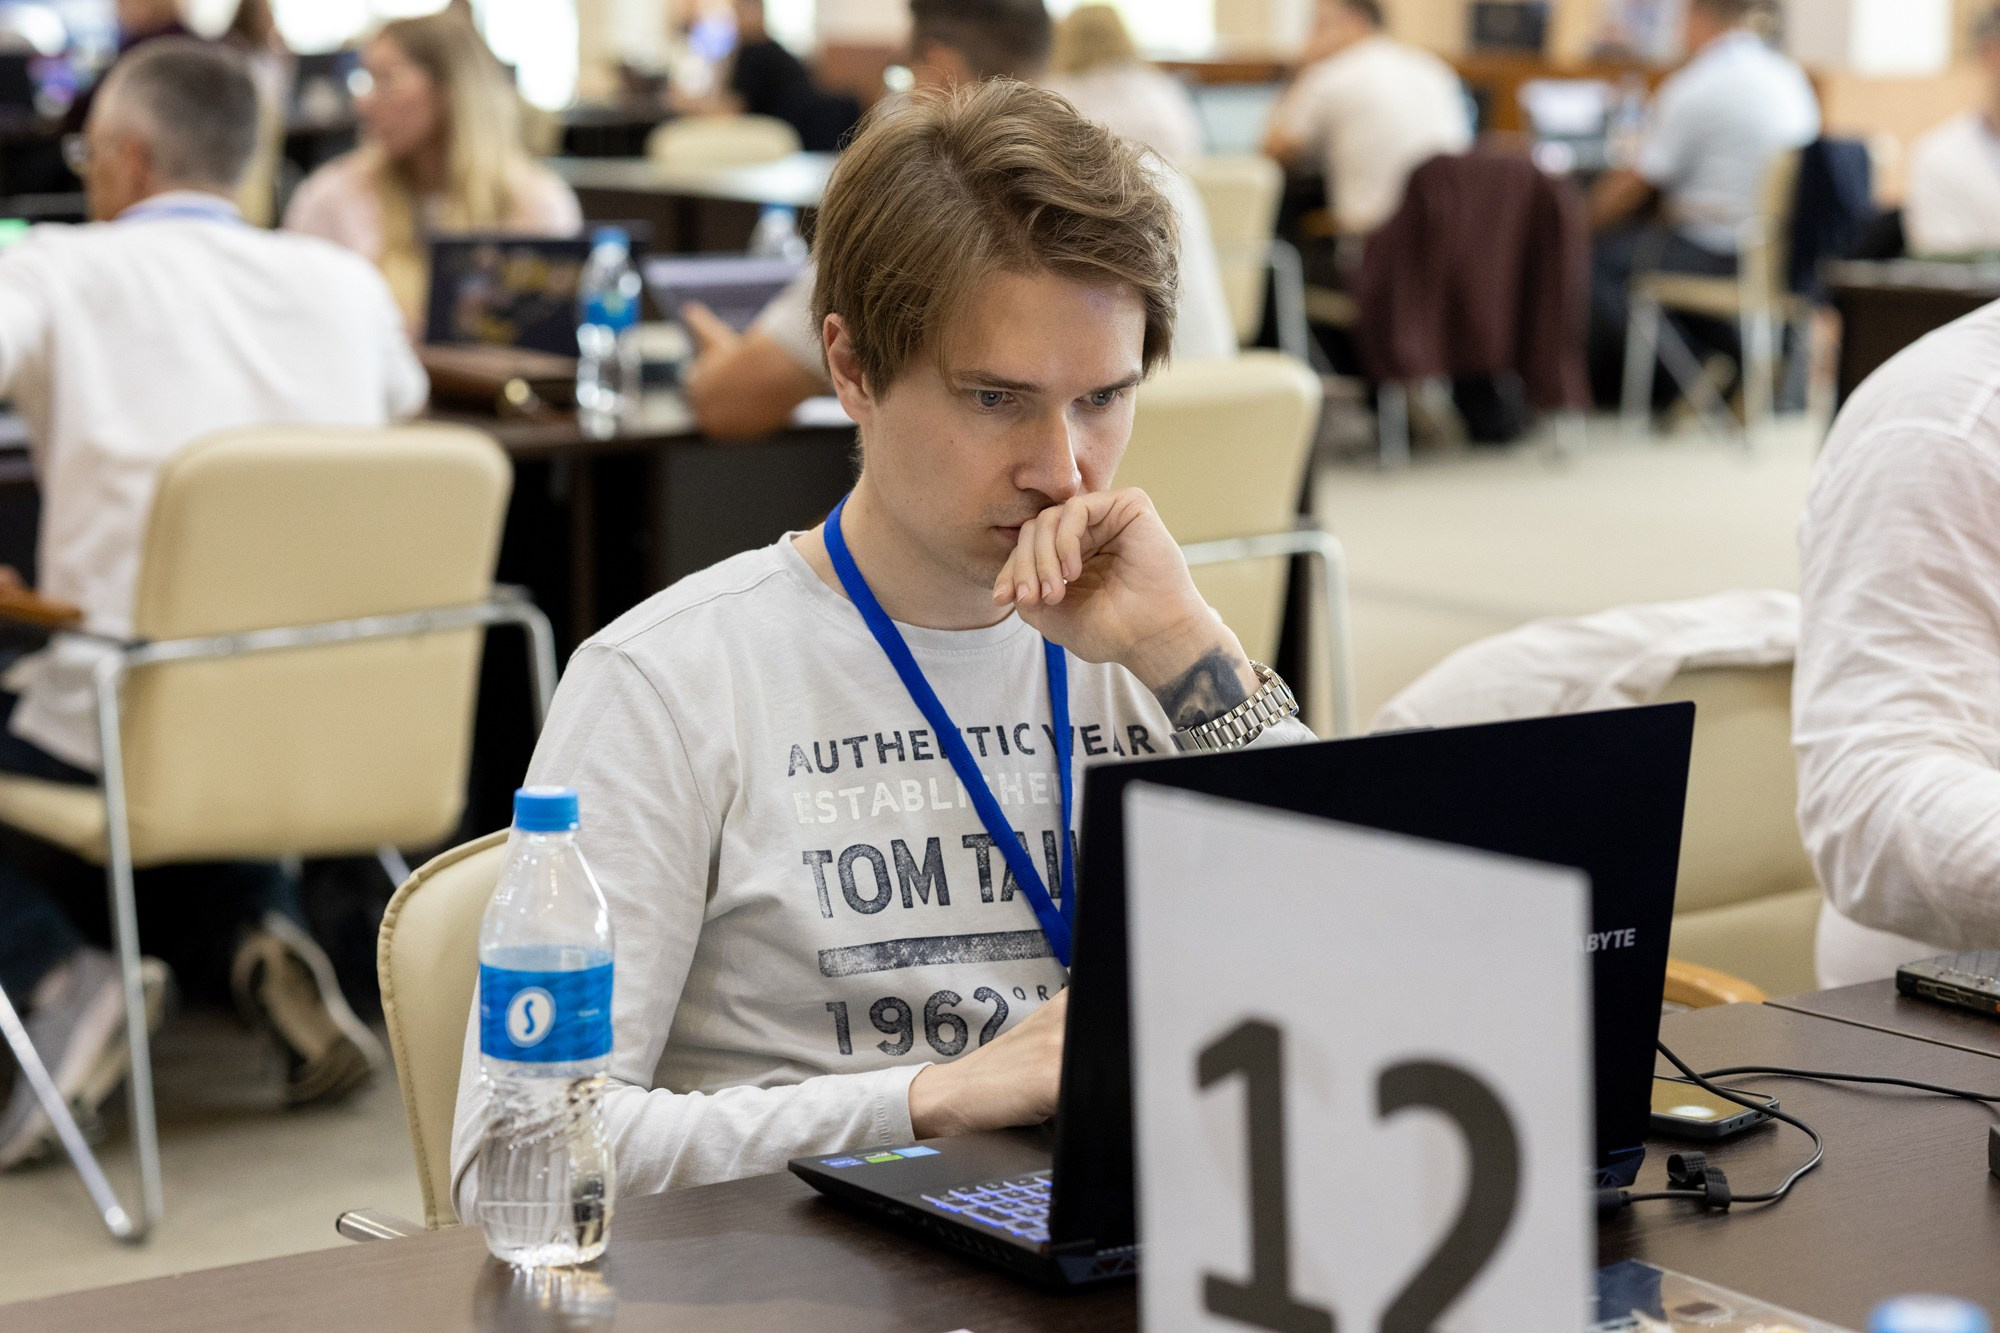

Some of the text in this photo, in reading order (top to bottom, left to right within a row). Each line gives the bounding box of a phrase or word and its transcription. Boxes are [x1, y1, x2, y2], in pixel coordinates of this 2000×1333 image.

[787, 722, 1035, 777] AUTHETIC
[793, 771, 1077, 825] ESTABLIHE
[802, 829, 1079, 919] TOM TAI
[825, 983, 1066, 1057] 1962 OR
[1194, 1016, 1525, 1333] 12
